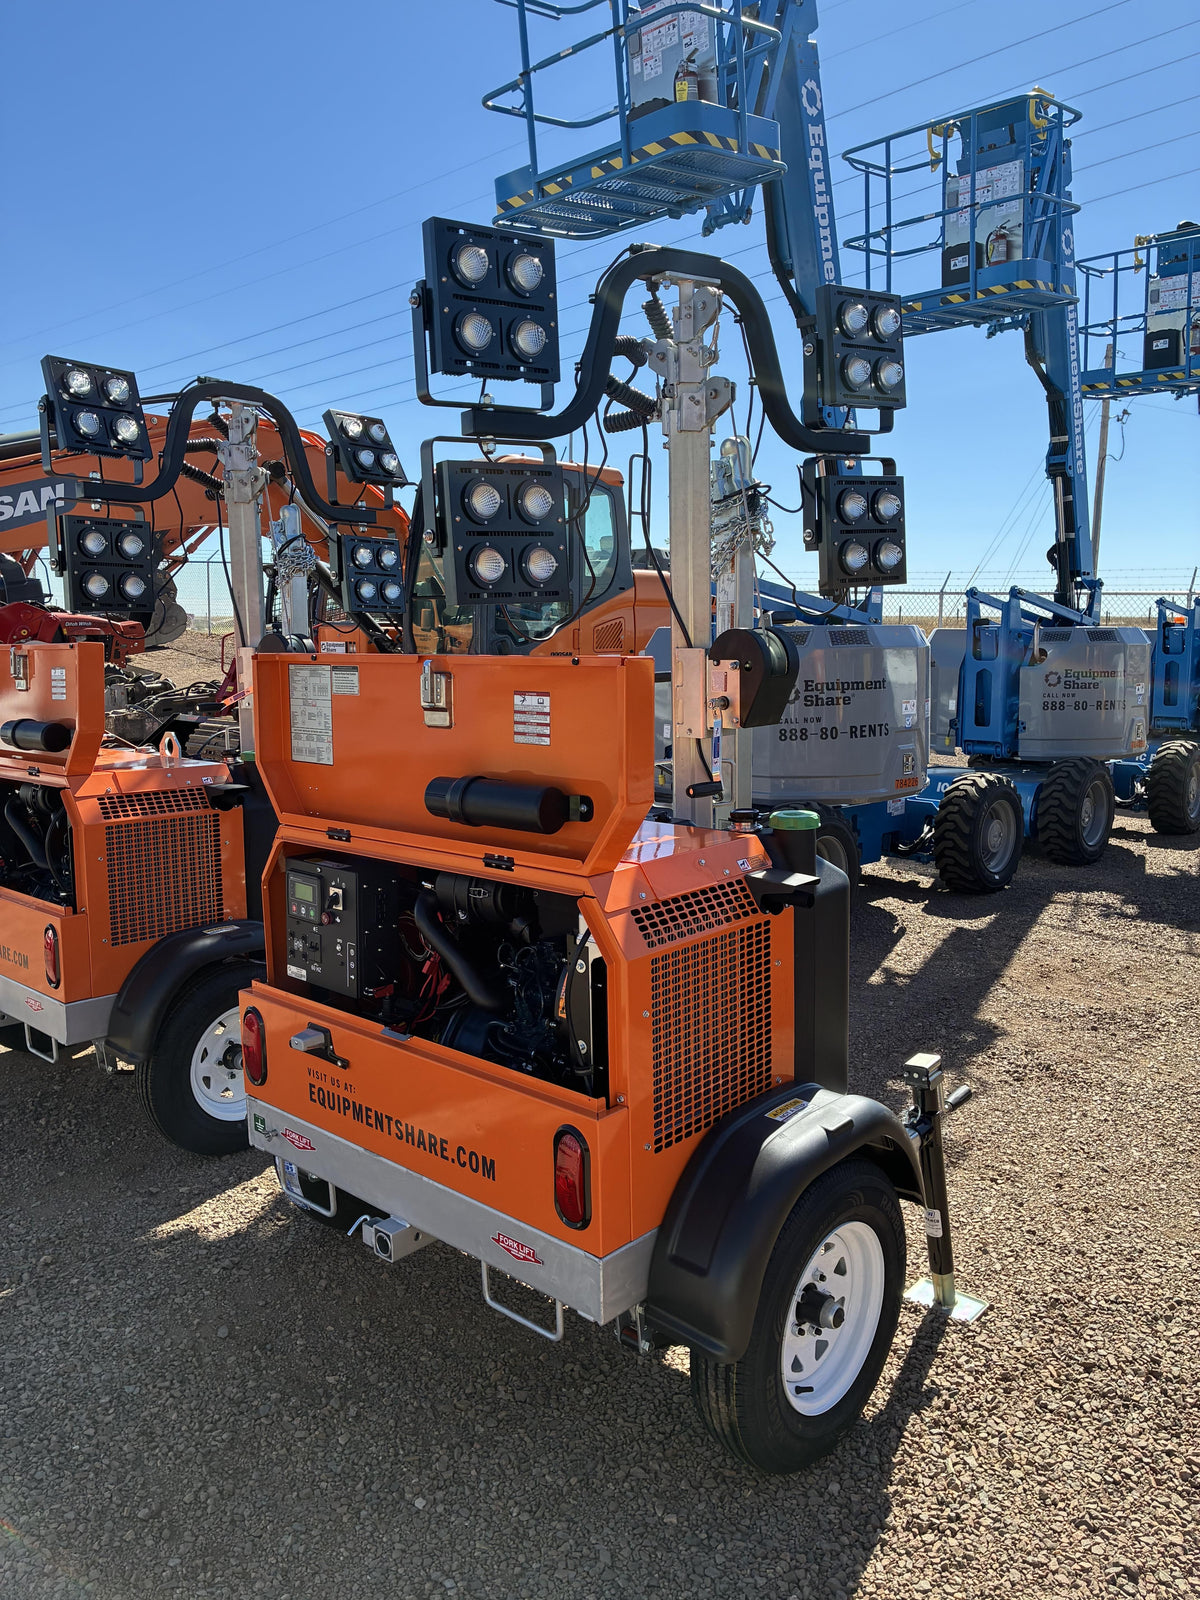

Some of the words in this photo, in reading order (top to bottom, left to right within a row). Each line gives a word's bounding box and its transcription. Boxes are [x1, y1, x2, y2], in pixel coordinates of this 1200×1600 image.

[808, 124, 836, 284] Equipme
[1064, 669, 1126, 681] Equipment
[803, 678, 887, 694] Equipment
[1064, 680, 1100, 690] Share
[803, 694, 853, 708] Share
[779, 723, 889, 742] 888-80-RENTS
[307, 1067, 327, 1083] VISIT
[330, 1077, 340, 1088] US
[344, 1082, 356, 1094] AT:
[286, 1130, 299, 1141] FORK
[300, 1136, 310, 1146] LIFT
[308, 1083, 496, 1181] EQUIPMENTSHARE.COM
[499, 1235, 518, 1250] FORK
[519, 1244, 534, 1257] LIFT
